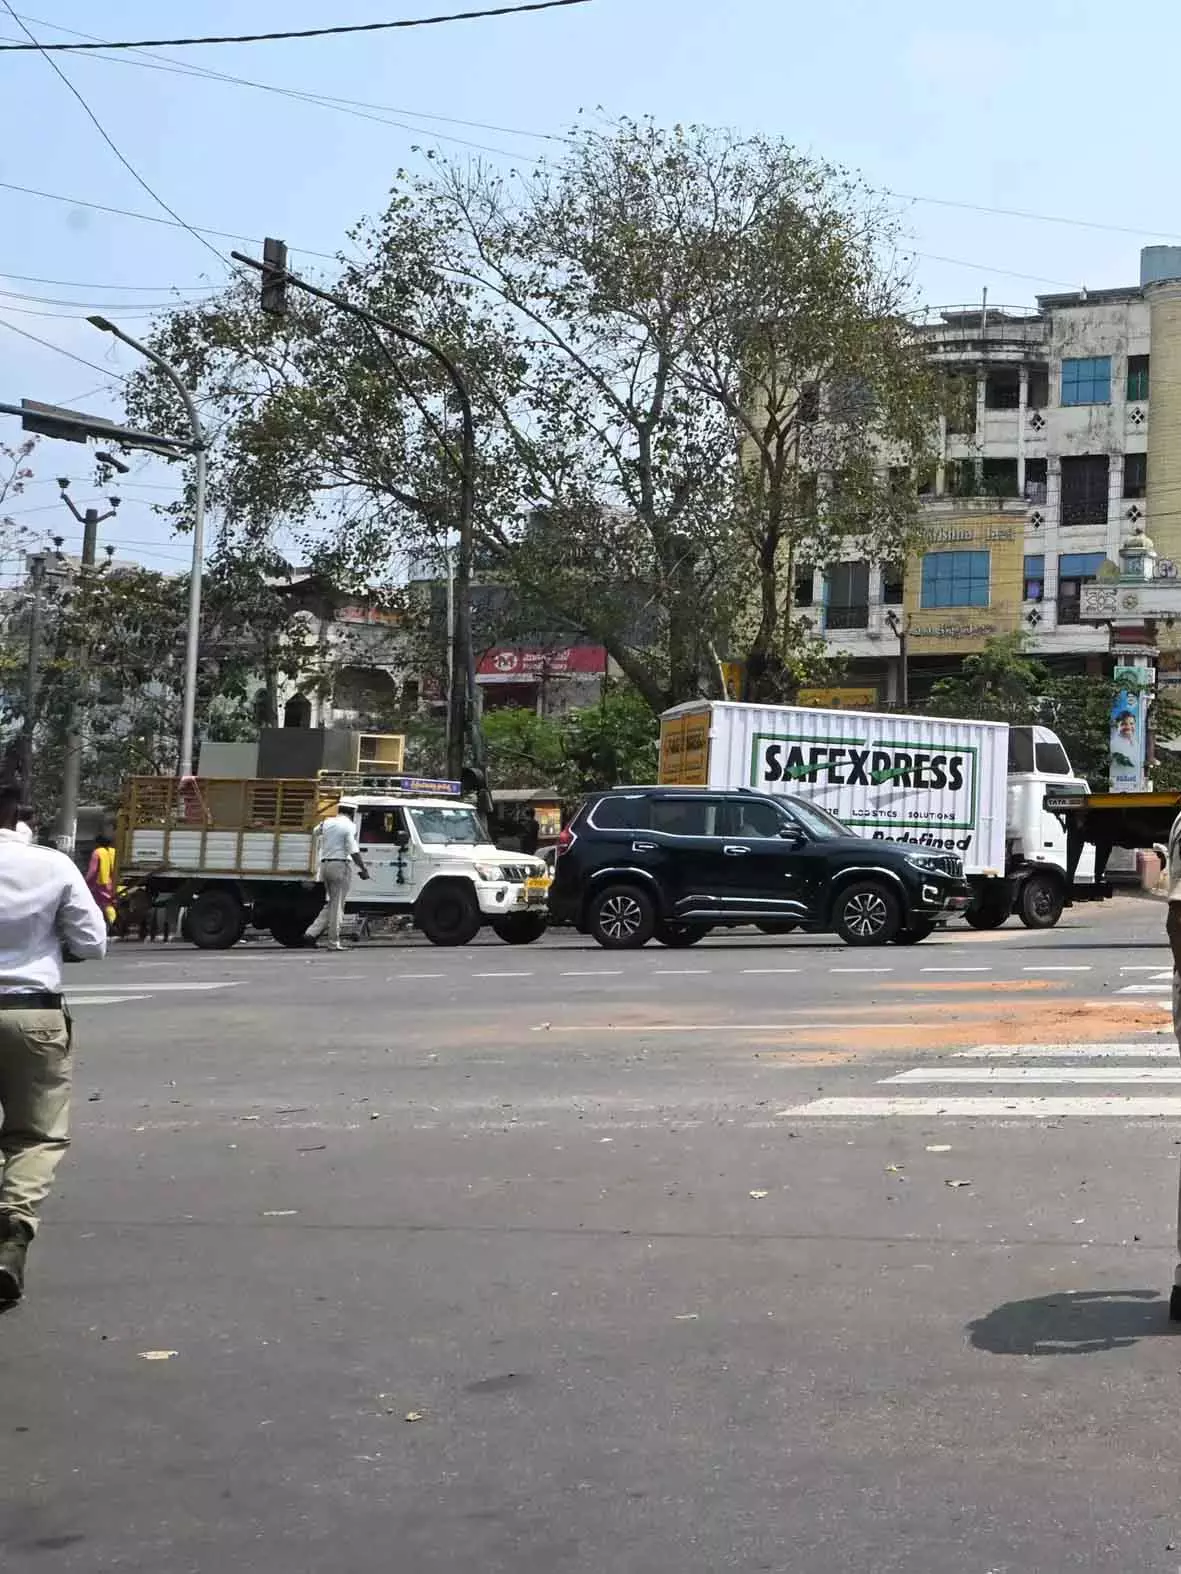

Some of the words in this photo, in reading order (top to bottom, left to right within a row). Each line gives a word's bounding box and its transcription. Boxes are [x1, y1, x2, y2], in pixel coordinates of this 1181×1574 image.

[764, 744, 964, 791] SAFEXPRESS
[852, 809, 898, 818] LOGISTICS
[908, 811, 956, 820] SOLUTIONS
